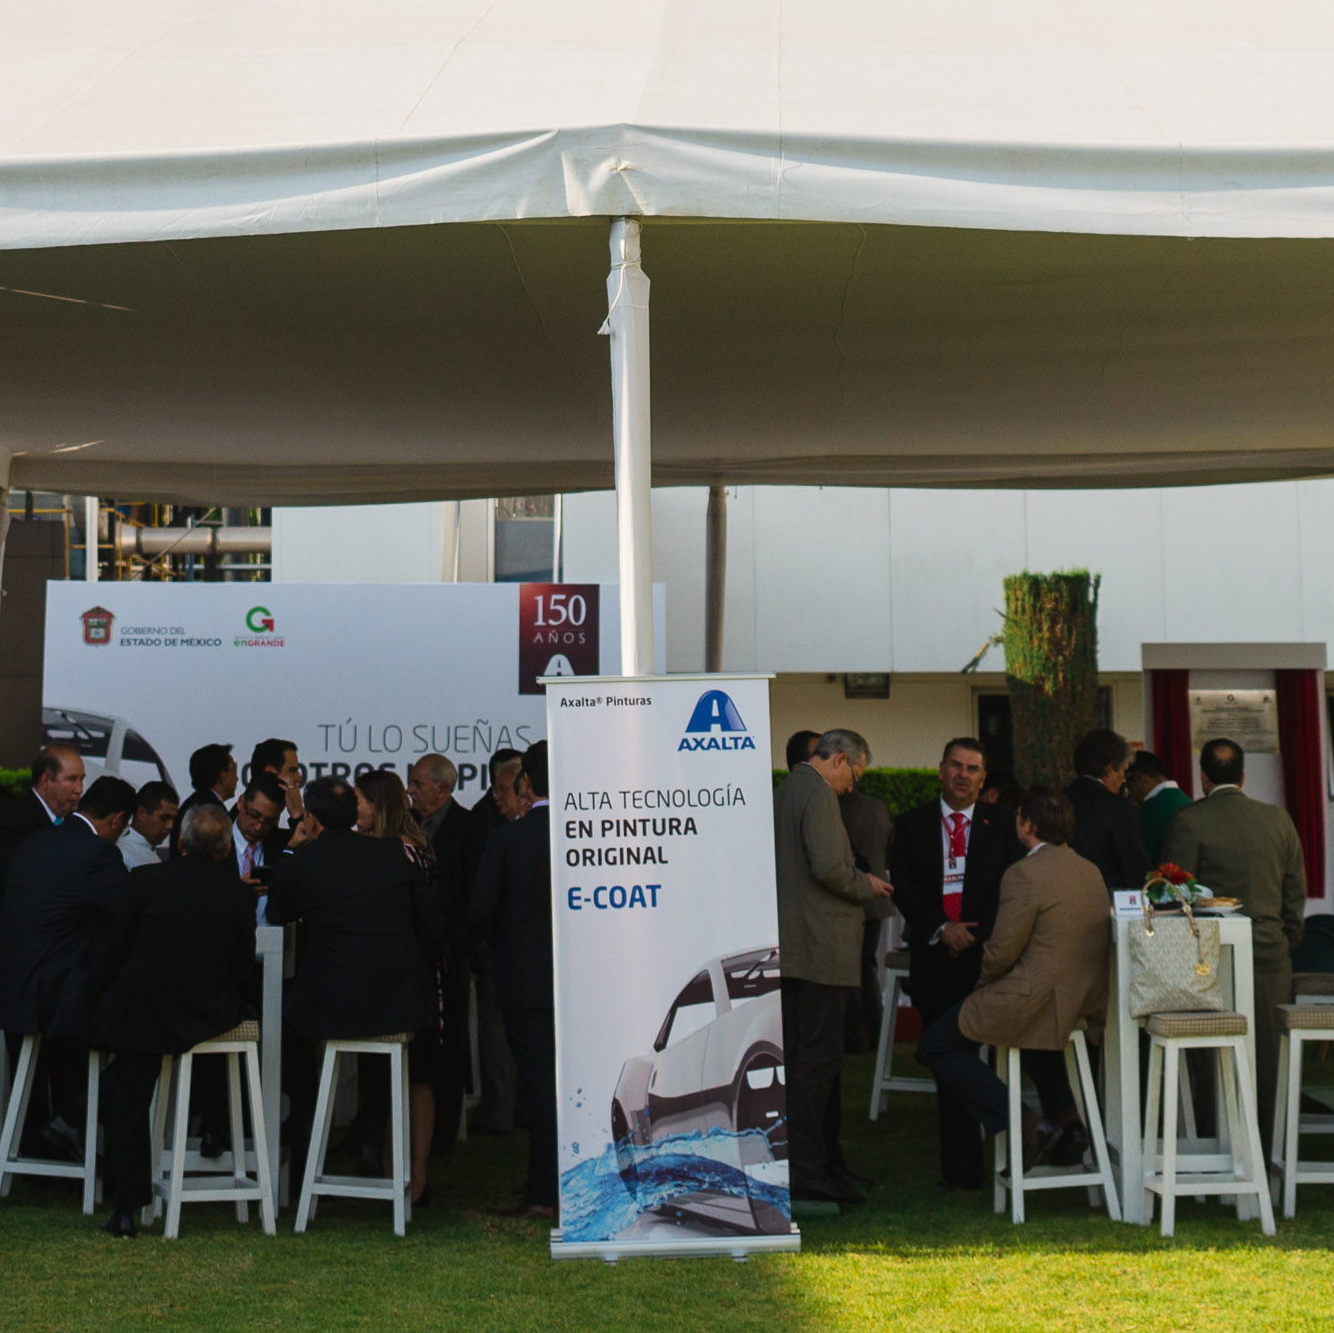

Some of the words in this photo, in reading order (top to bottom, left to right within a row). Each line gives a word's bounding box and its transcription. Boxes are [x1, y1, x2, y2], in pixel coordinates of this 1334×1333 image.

[534, 594, 586, 626] 150
[120, 638, 162, 647] ESTADO
[164, 638, 178, 647] DE
[180, 636, 222, 647] MÉXICO
[170, 627, 186, 635] DEL
[533, 629, 586, 644] AÑOS
[606, 696, 652, 707] Pinturas
[318, 717, 357, 753] TÚ
[368, 724, 403, 753] LO
[677, 736, 756, 752] AXALTA
[564, 791, 612, 811] ALTA
[619, 783, 746, 809] TECNOLOGÍA
[566, 820, 593, 839] EN
[601, 817, 698, 838] PINTURA
[566, 846, 669, 867] ORIGINAL
[567, 884, 662, 910] E-COAT
